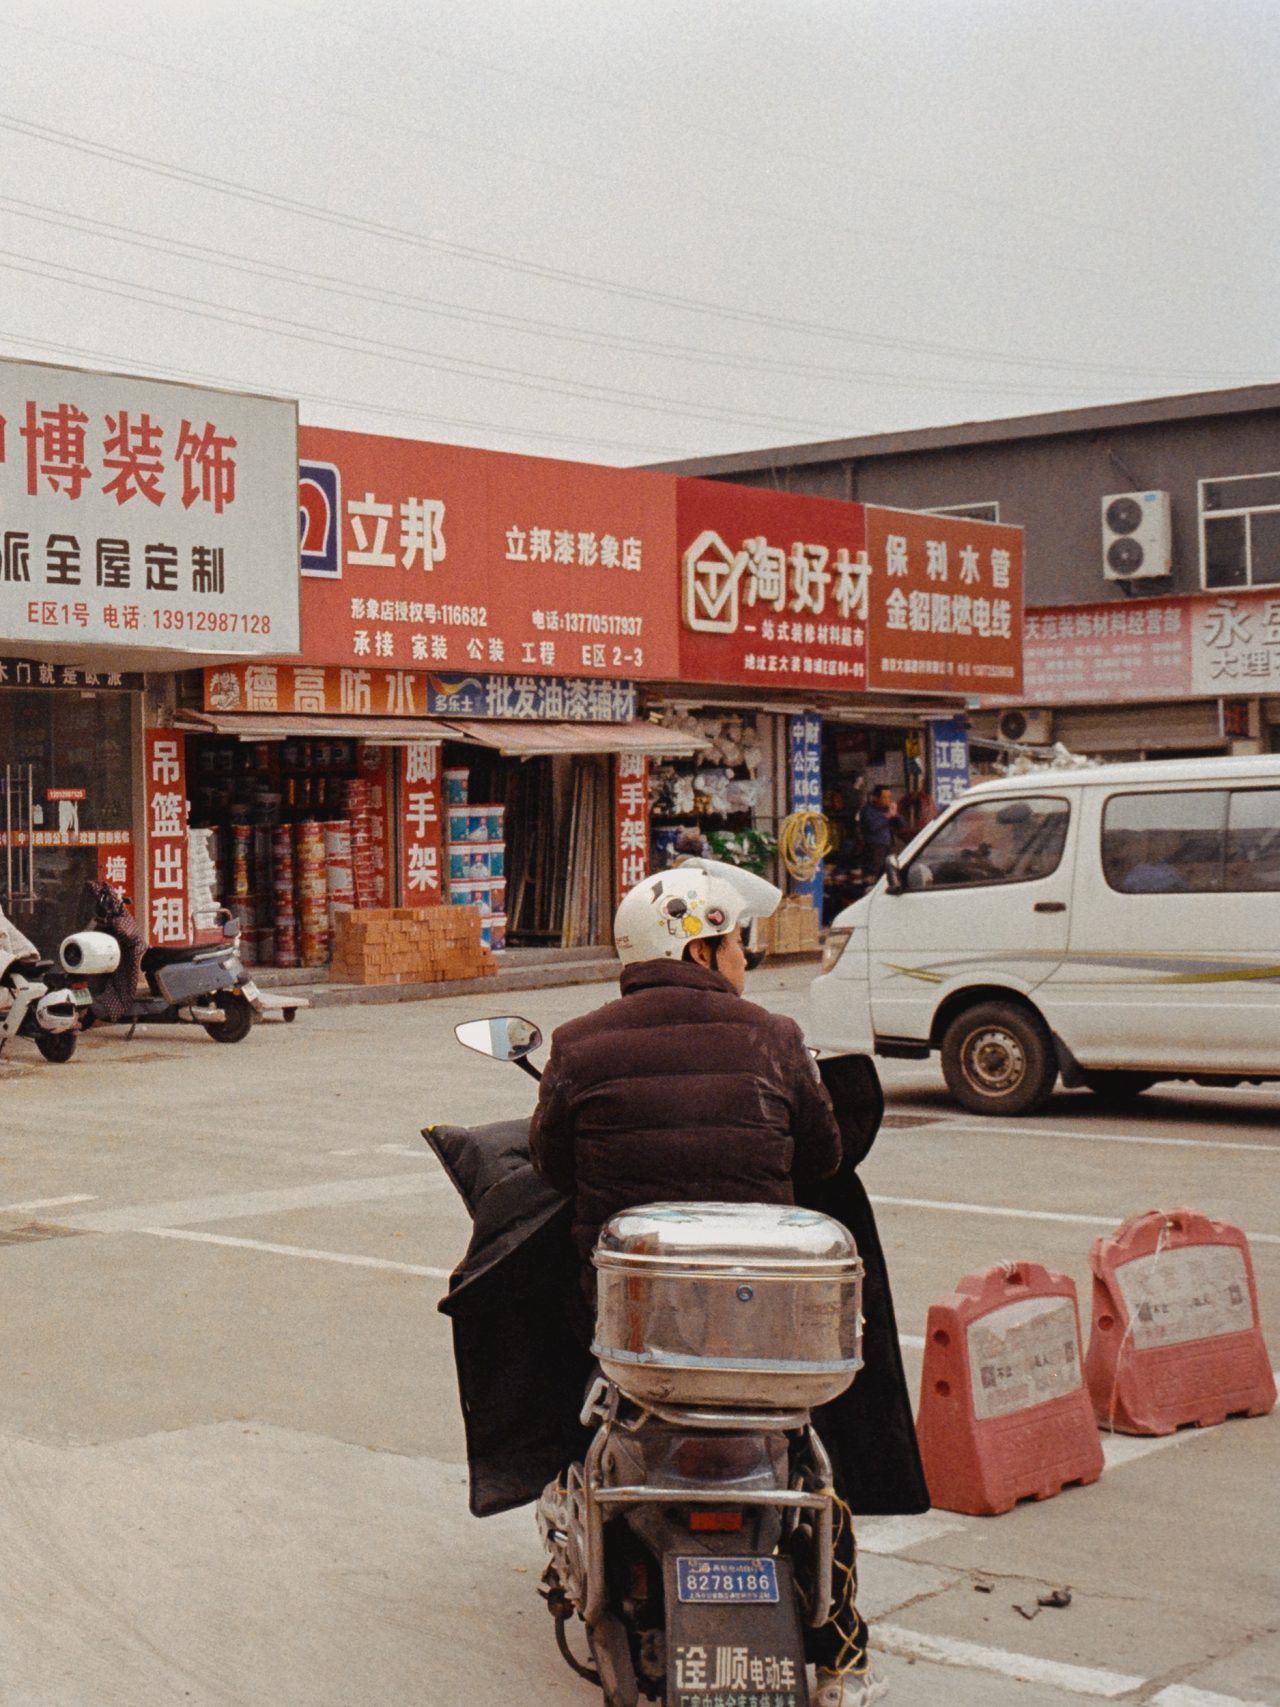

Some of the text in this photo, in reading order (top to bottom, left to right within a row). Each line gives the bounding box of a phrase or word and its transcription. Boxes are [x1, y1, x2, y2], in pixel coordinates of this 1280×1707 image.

[347, 492, 446, 571] 立邦
[505, 525, 642, 572] 立邦漆形象店
[743, 536, 872, 620] 淘好材
[886, 535, 1011, 588] 保利水管
[28, 601, 90, 627] E区1号
[532, 610, 642, 636] 电话:13770517937
[353, 630, 394, 656] 承接
[412, 633, 448, 660] 家装
[466, 637, 504, 663] 公装
[522, 641, 555, 666] 工程
[1210, 650, 1280, 679] 大理
[244, 665, 415, 713] 德高防水
[435, 695, 474, 713] 多乐士
[486, 675, 636, 721] 批发油漆辅材
[151, 741, 186, 943] 吊篮出租
[620, 753, 646, 892] 脚手架出
[687, 1575, 770, 1590] 8278186
